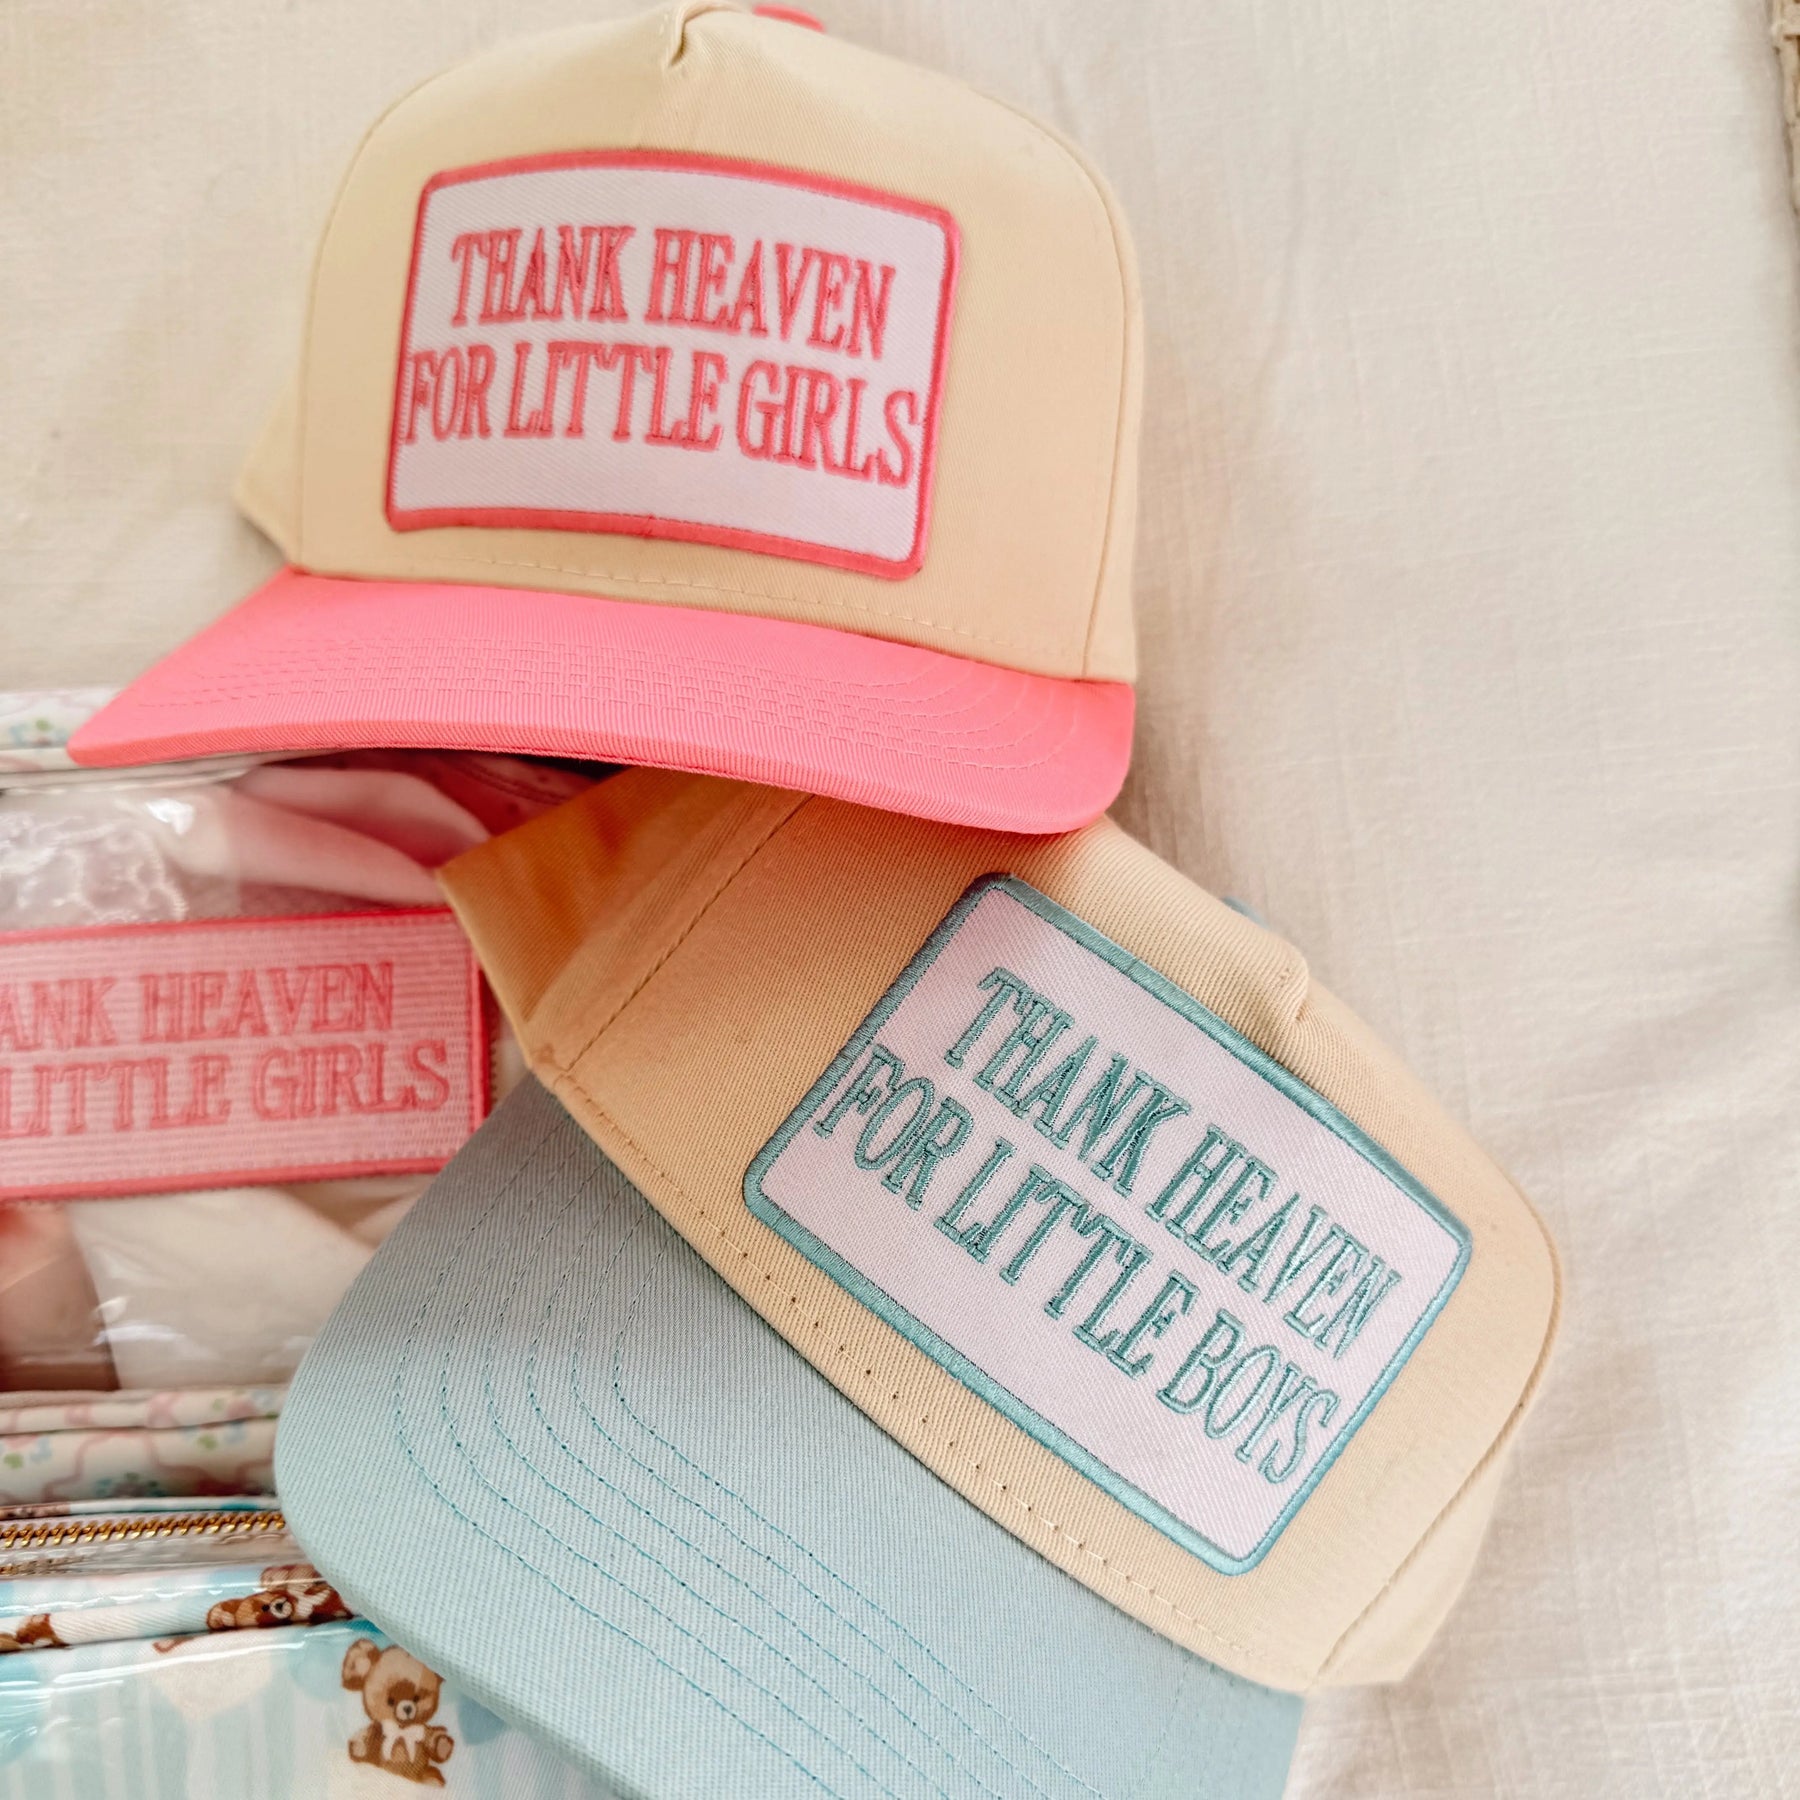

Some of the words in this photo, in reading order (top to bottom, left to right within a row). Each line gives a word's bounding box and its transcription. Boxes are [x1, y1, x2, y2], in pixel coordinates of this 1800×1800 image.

[451, 225, 636, 326] THANK
[644, 227, 896, 360] HEAVEN
[401, 344, 495, 445] FOR
[503, 341, 728, 451] LITTLE
[737, 360, 919, 488] GIRLS
[138, 961, 394, 1043] HEAVEN
[250, 1040, 450, 1121] GIRLS
[945, 967, 1192, 1197] THANK
[1145, 1123, 1401, 1361] HEAVEN
[815, 1043, 976, 1211] FOR
[933, 1138, 1199, 1379] LITTLE
[1156, 1308, 1341, 1485] BOYS
